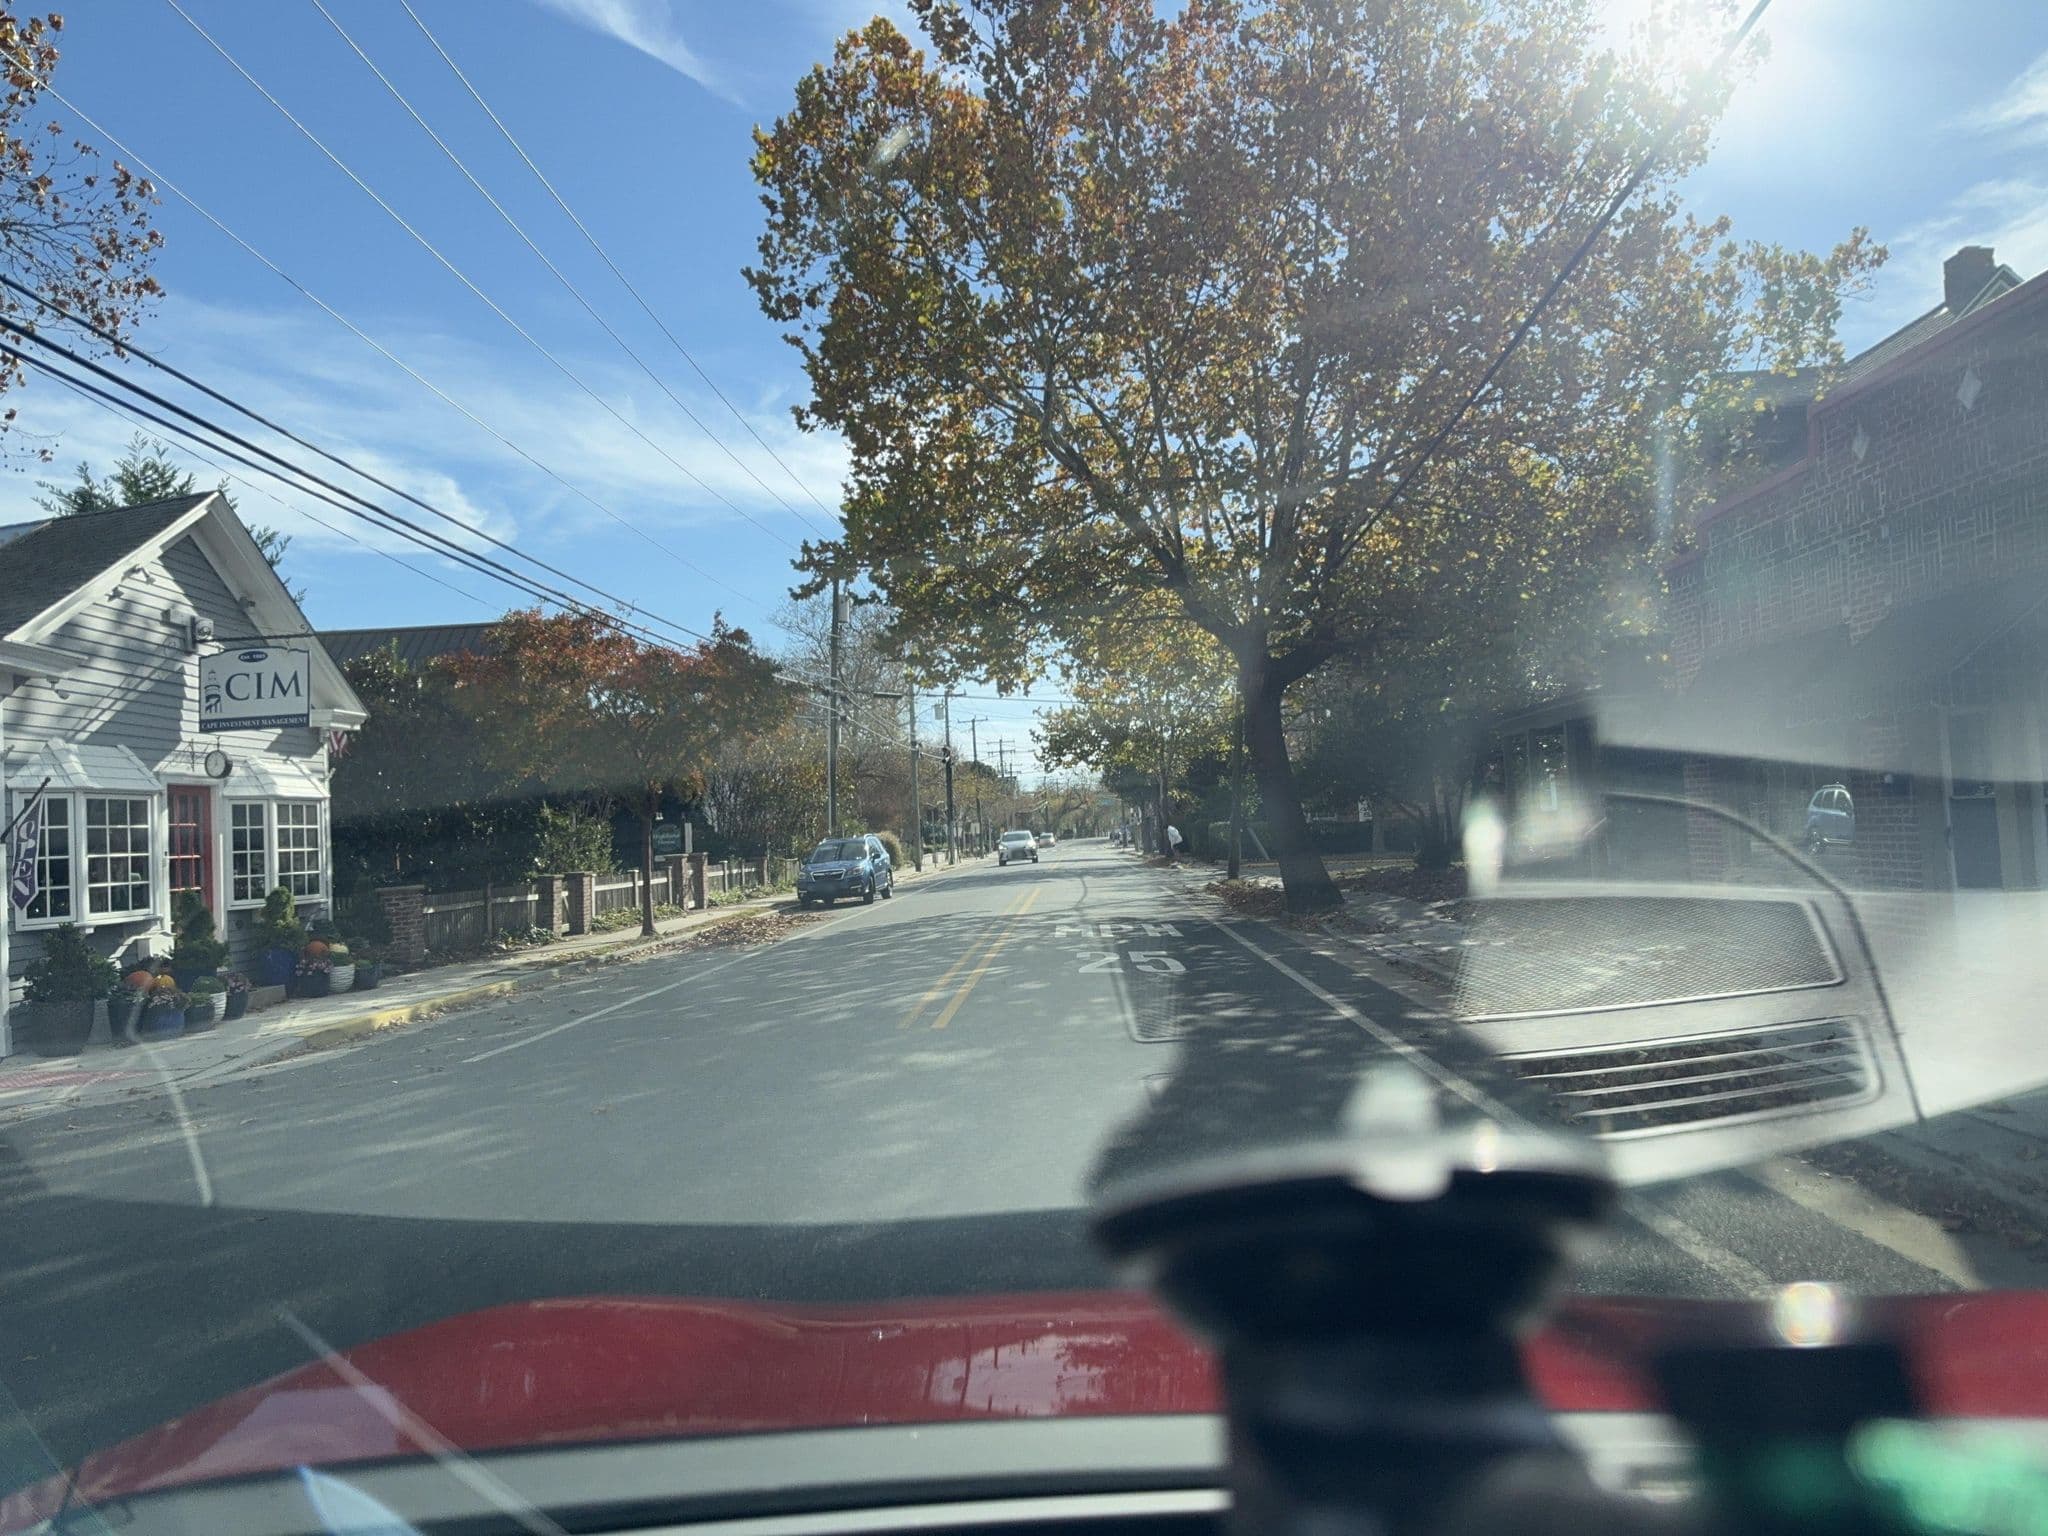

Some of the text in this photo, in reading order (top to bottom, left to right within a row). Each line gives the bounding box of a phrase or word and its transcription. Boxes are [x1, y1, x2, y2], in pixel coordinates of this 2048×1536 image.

[225, 670, 303, 701] CIM
[219, 719, 260, 728] INVESTMENT
[261, 717, 307, 726] MANAGEMENT
[1054, 923, 1185, 938] MPH
[1076, 951, 1187, 973] 25
